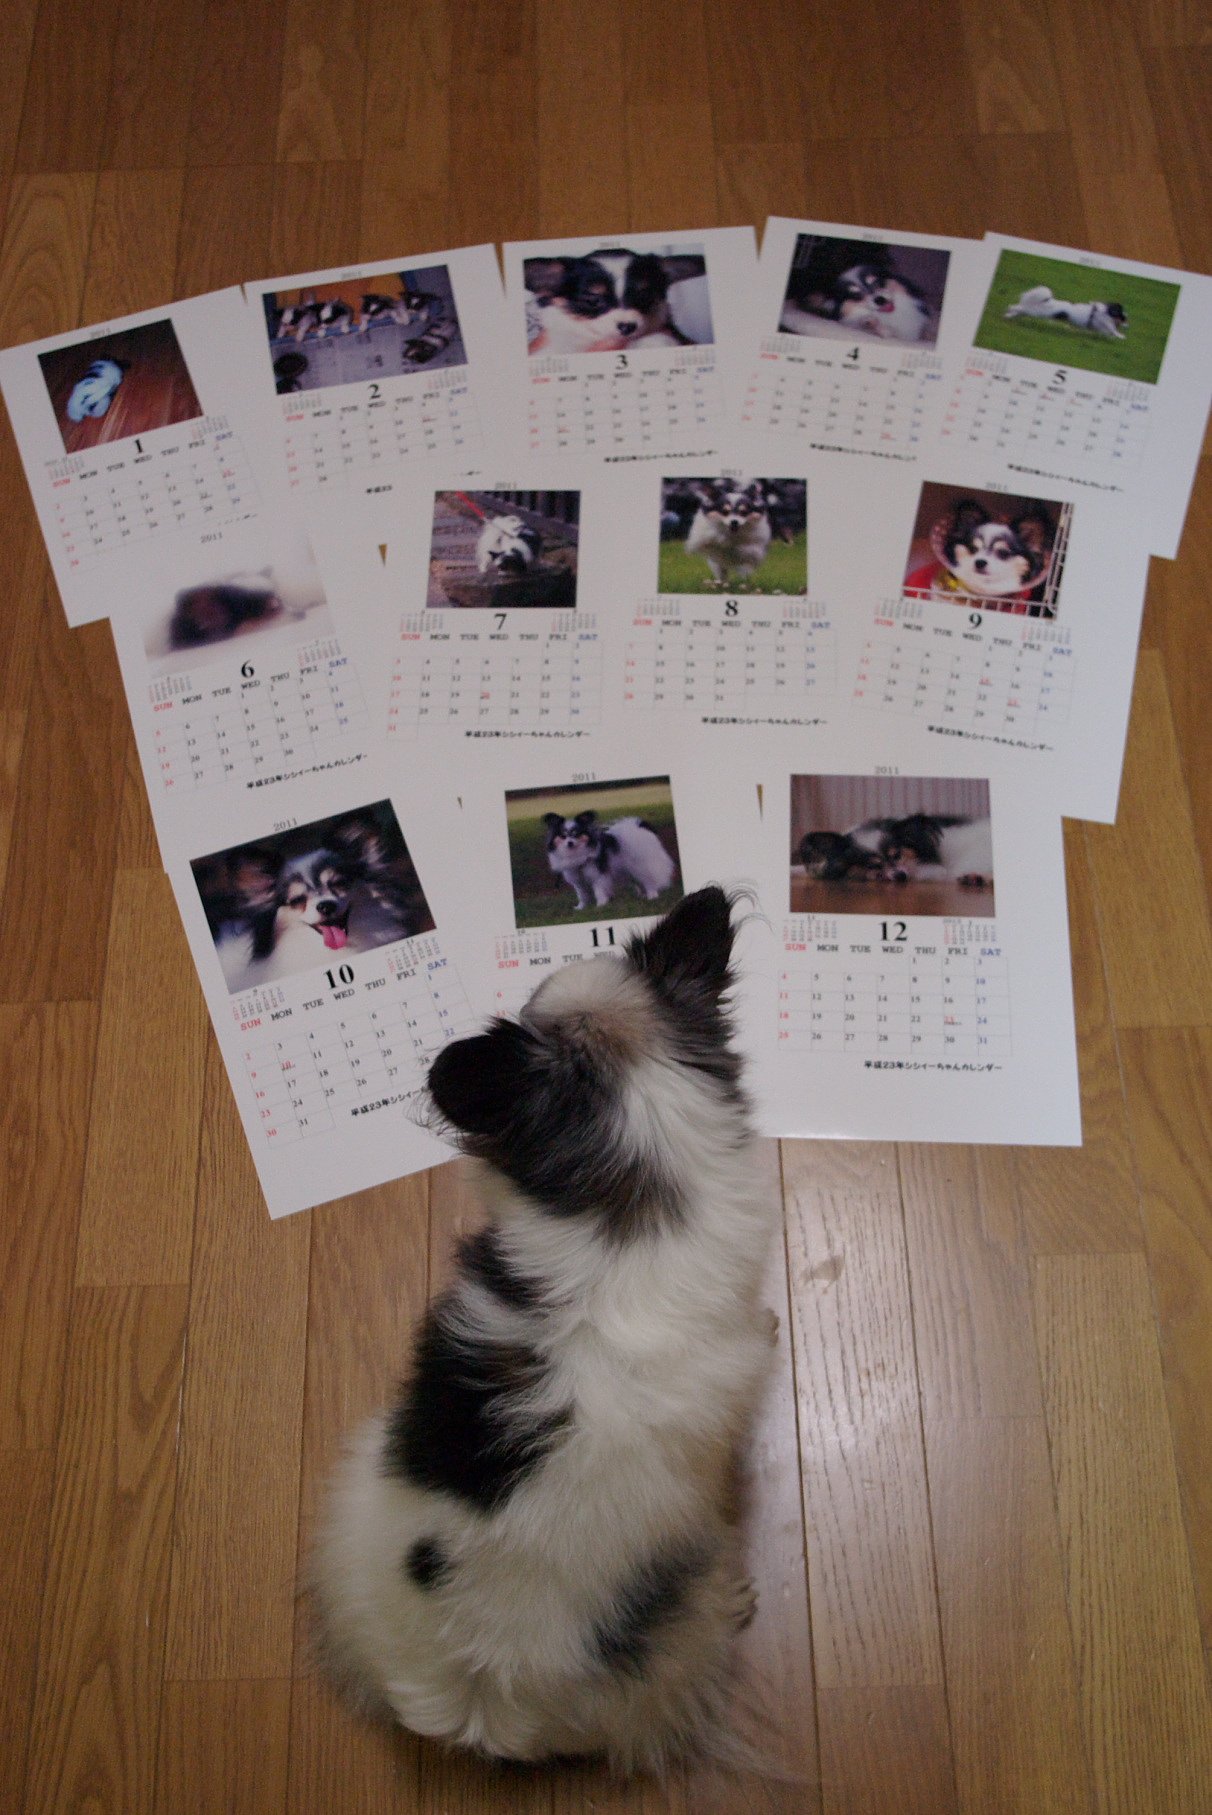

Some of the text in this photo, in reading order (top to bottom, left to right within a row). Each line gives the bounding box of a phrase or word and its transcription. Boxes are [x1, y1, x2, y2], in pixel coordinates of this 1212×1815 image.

[616, 354, 629, 370] 3
[846, 347, 860, 362] 4
[1052, 370, 1067, 384] 5
[368, 384, 382, 400] 2
[134, 439, 144, 454] 1
[725, 600, 739, 617] 8
[494, 613, 508, 630] 7
[969, 613, 983, 629] 9
[240, 661, 255, 678] 6
[153, 658, 348, 712] SUN MON TUE WED THU FRI SAT
[572, 773, 597, 782] 2011
[875, 766, 900, 775] 2011
[273, 818, 299, 832] 2011
[590, 927, 615, 947] 11
[880, 922, 908, 942] 12
[785, 943, 1002, 956] SUN MON TUE WED THU FRI SAT
[498, 960, 520, 969] SUN
[530, 957, 552, 966] MON
[562, 954, 585, 964] TUE
[324, 964, 355, 990] 10
[240, 958, 448, 1031] SUN MON TUE WED THU FRI SAT
[313, 1050, 322, 1059] 11
[344, 1040, 354, 1049] 12
[376, 1030, 386, 1039] 13
[407, 1020, 417, 1028] 14
[438, 1009, 448, 1018] 15
[287, 1079, 296, 1088] 17
[319, 1069, 329, 1078] 18
[351, 1059, 360, 1068] 19
[381, 1048, 392, 1058] 20
[413, 1038, 423, 1047] 21
[260, 1057, 431, 1118] 23 24 25 26 27 28
[266, 1118, 308, 1138] 30 31
